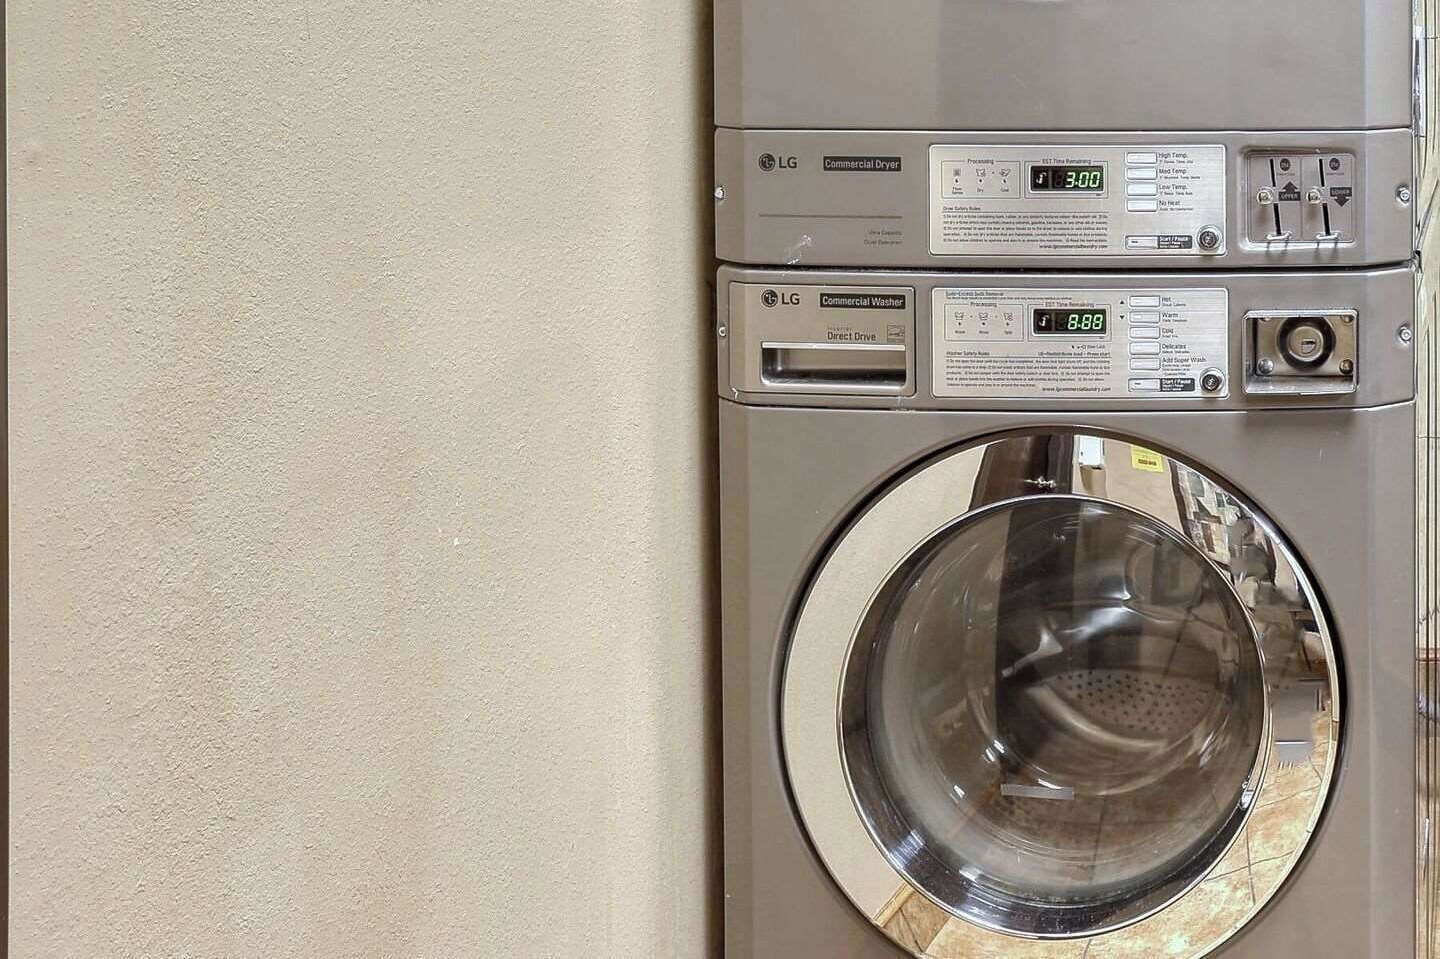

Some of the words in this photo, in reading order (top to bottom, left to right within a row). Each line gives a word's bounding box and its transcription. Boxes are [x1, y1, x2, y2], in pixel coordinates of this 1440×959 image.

[779, 157, 797, 168] LG
[825, 159, 874, 168] Commercial
[876, 160, 898, 170] Dryer
[782, 293, 800, 305] LG
[823, 296, 870, 306] Commercial
[872, 298, 903, 307] Washer
[827, 332, 852, 341] Direct
[855, 332, 876, 341] Drive
